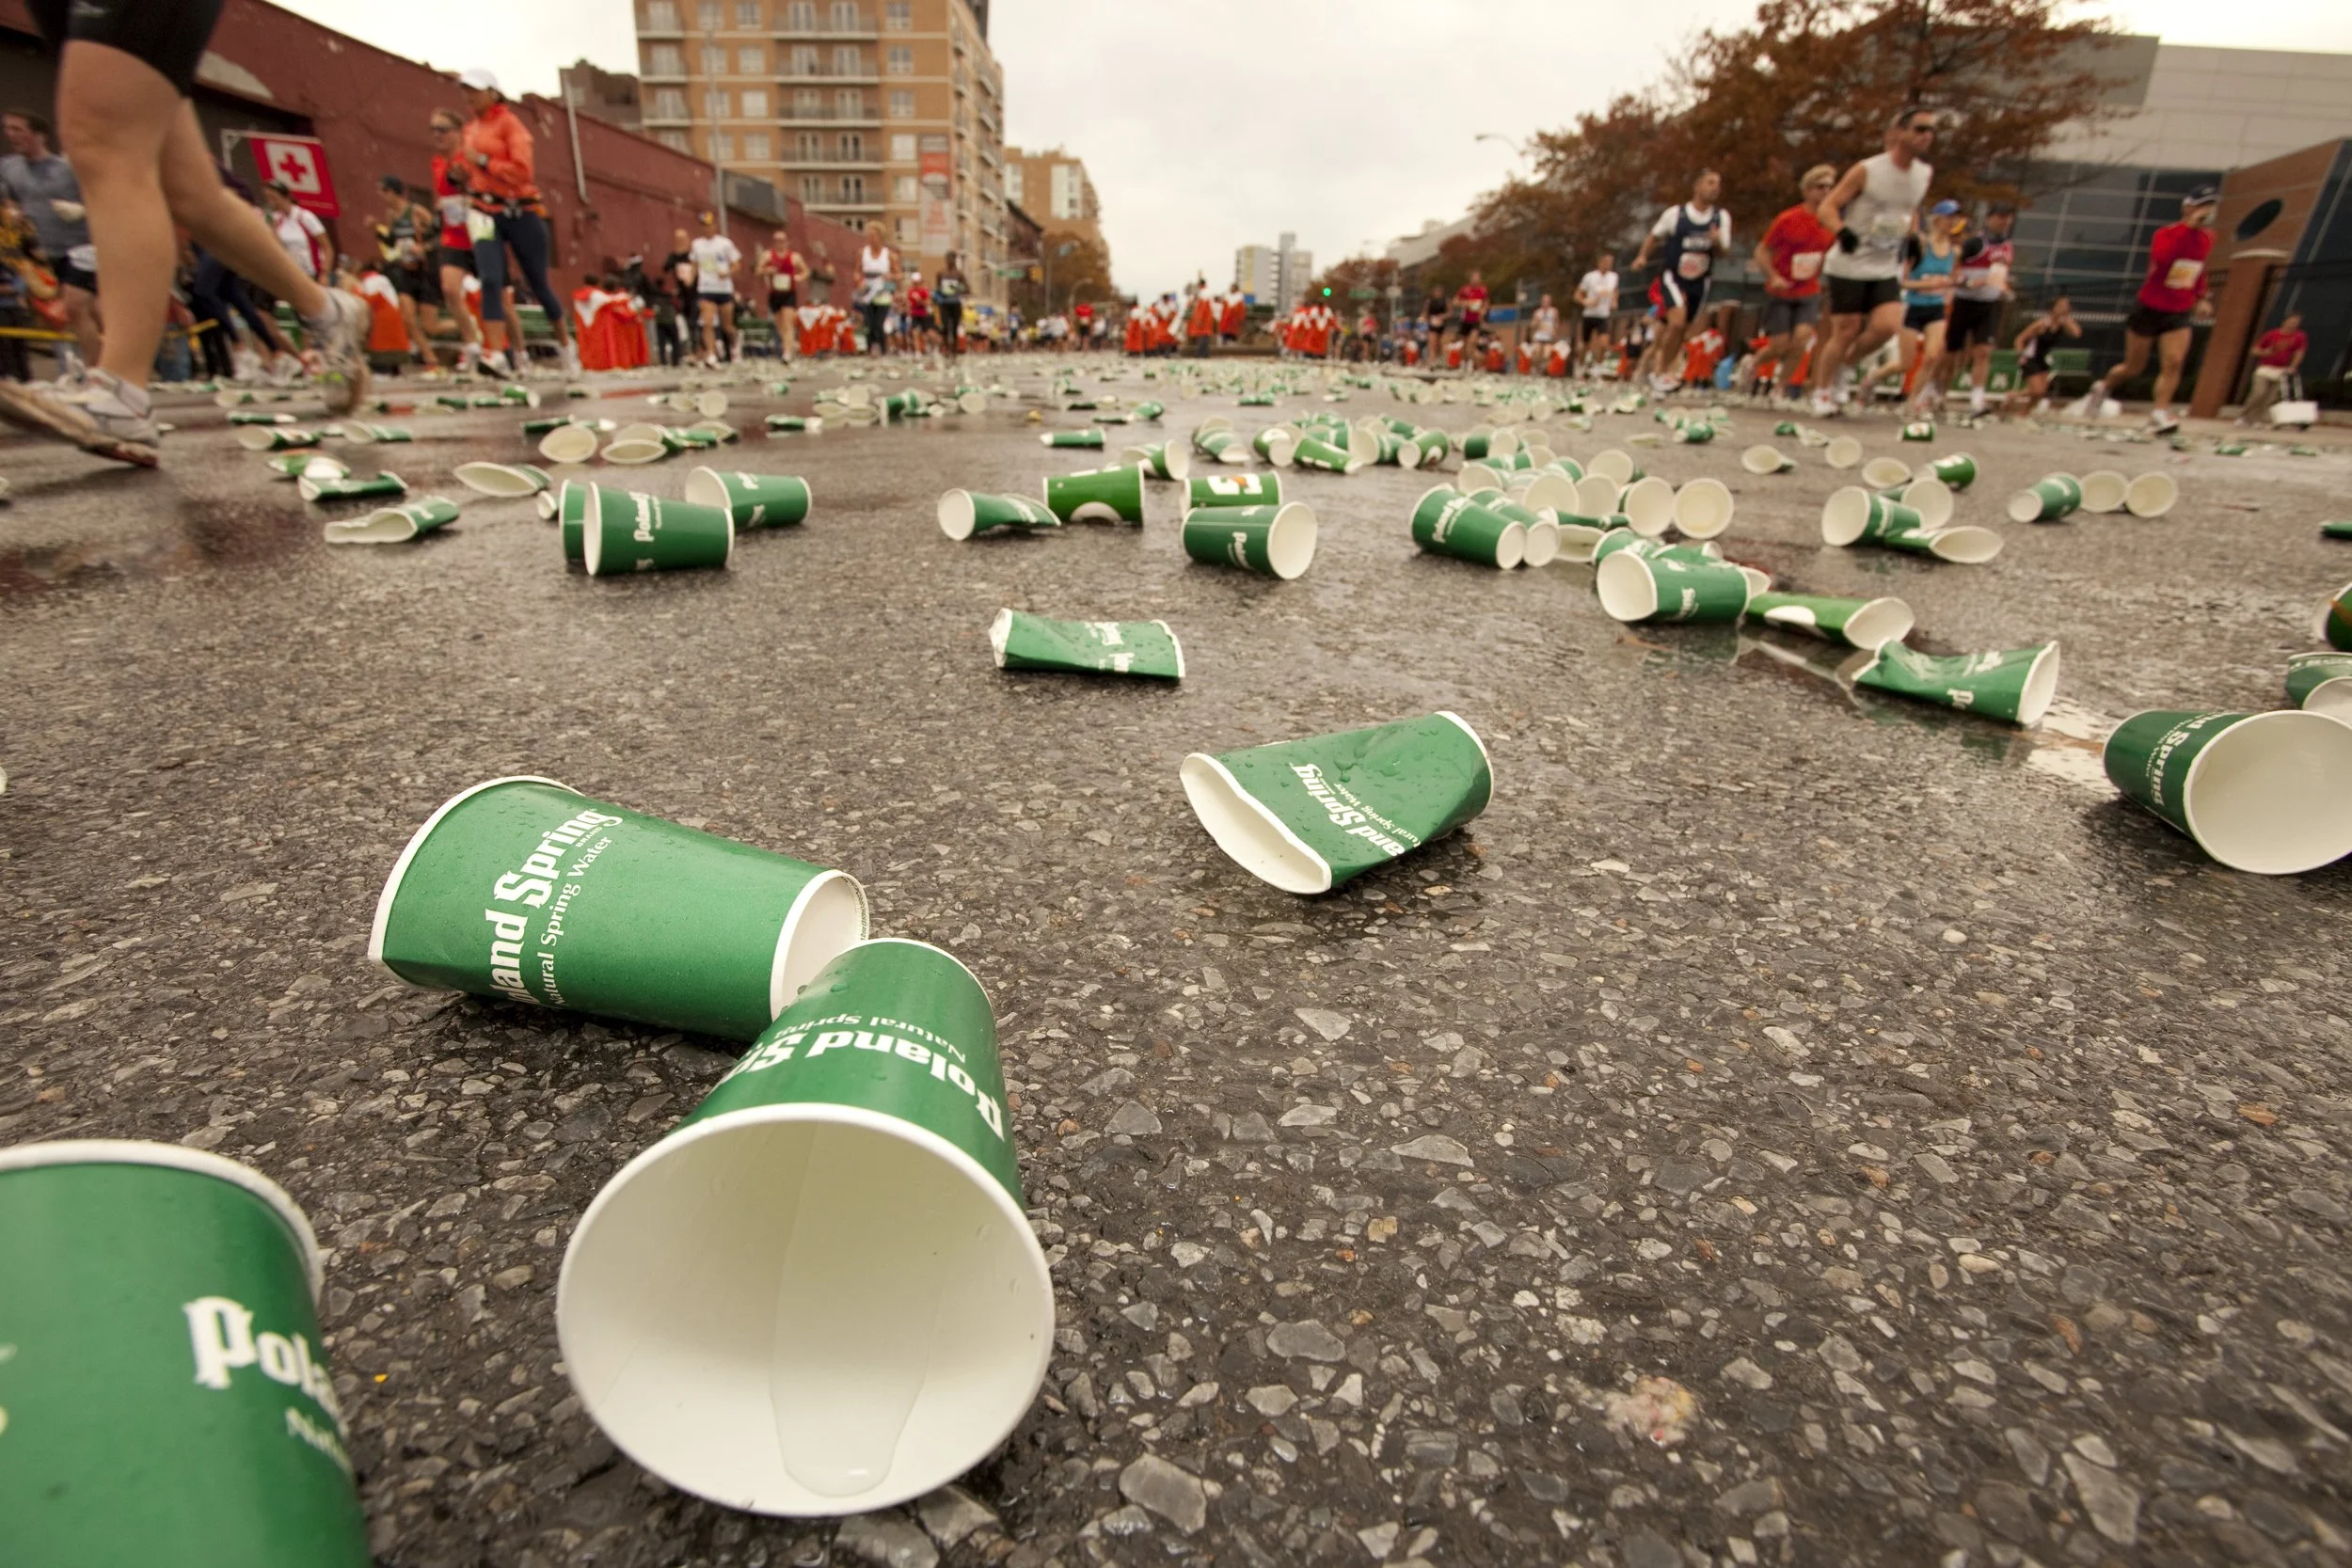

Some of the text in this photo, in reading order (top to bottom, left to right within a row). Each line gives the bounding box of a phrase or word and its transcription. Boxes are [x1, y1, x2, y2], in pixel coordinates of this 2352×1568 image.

[1292, 763, 1367, 827] Spring
[485, 810, 624, 1005] oland Spring
[540, 882, 581, 947] Spring
[566, 835, 613, 878] Water
[804, 1029, 1005, 1144] Poland
[868, 1016, 967, 1064] Natural
